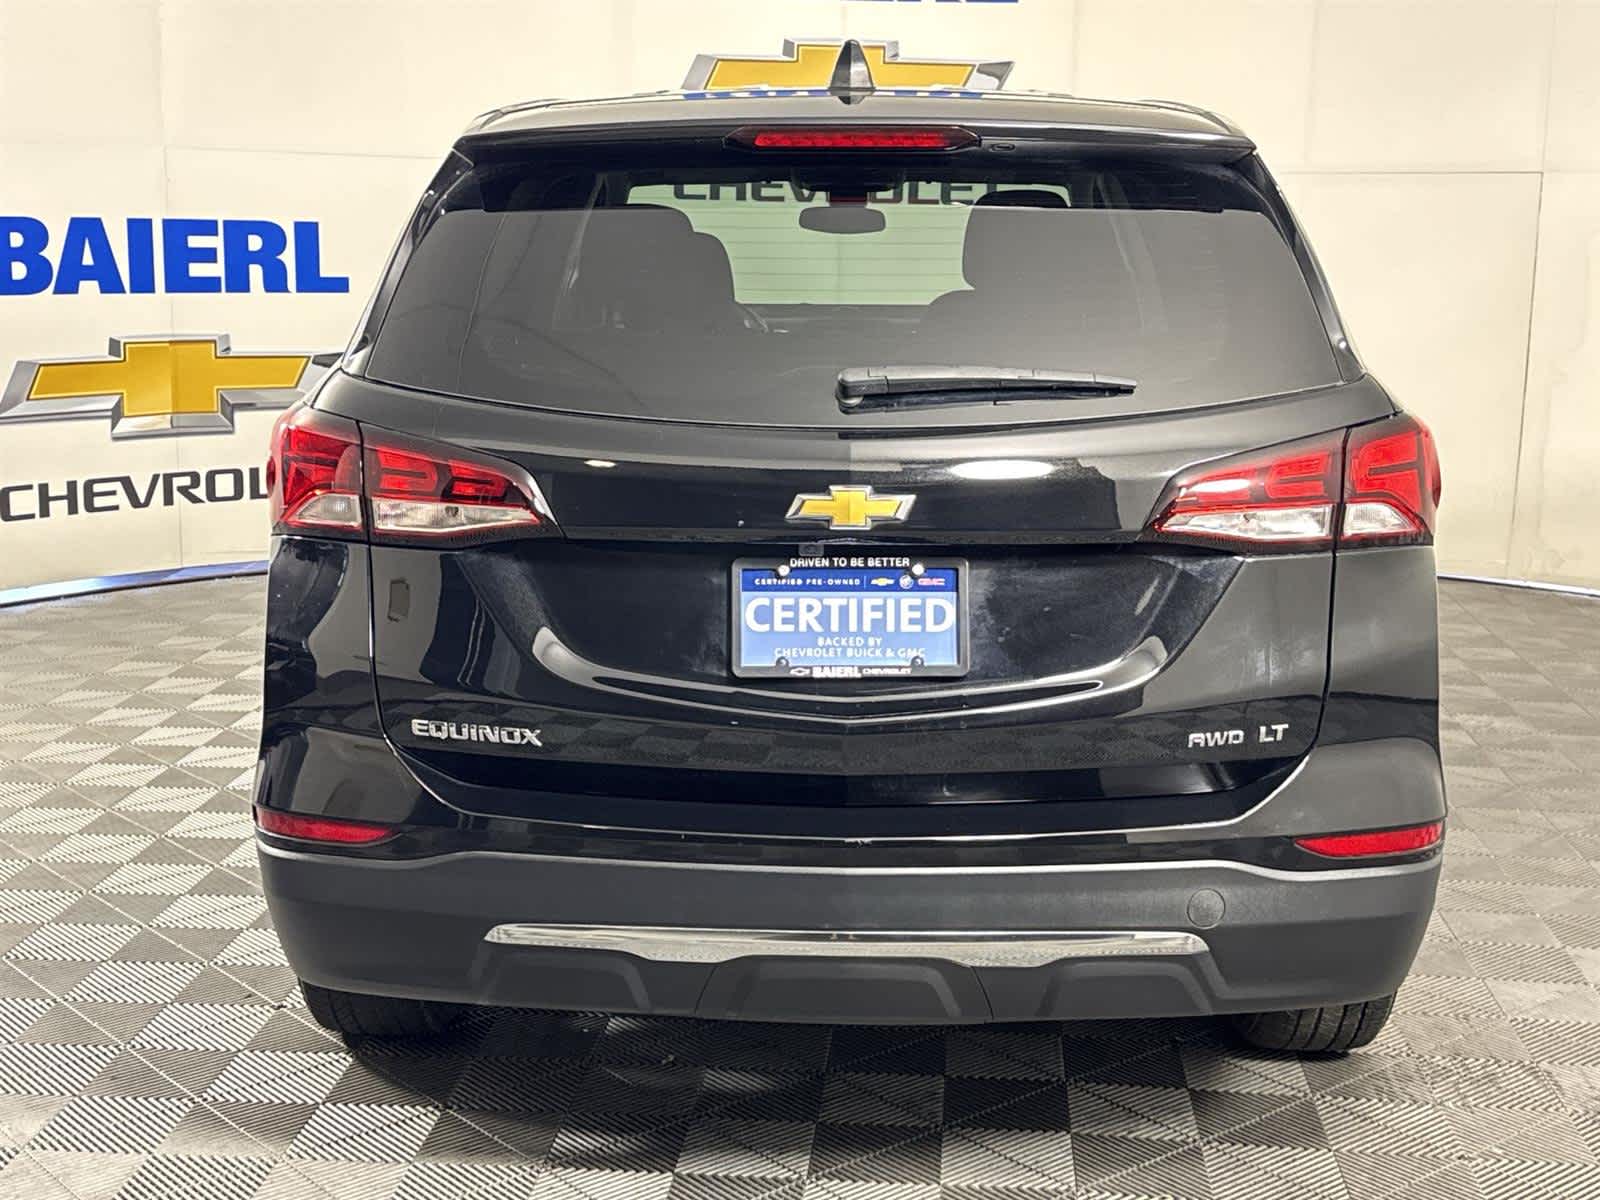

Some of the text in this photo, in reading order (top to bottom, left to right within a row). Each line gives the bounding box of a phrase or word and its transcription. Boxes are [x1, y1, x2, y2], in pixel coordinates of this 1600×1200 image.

[0, 216, 349, 296] BAIERL
[790, 557, 910, 568] DRIVEN TO BE BETTER
[754, 578, 803, 586] CERTIFIED
[917, 577, 946, 586] GMC
[744, 597, 956, 633] CERTIFIED
[817, 636, 883, 648] BACKED BY
[774, 647, 926, 658] CHEVROLET BUICK & GMC
[812, 666, 861, 679] BAIERL
[411, 719, 543, 747] EQUINOX
[1187, 723, 1289, 749] AWD LT
